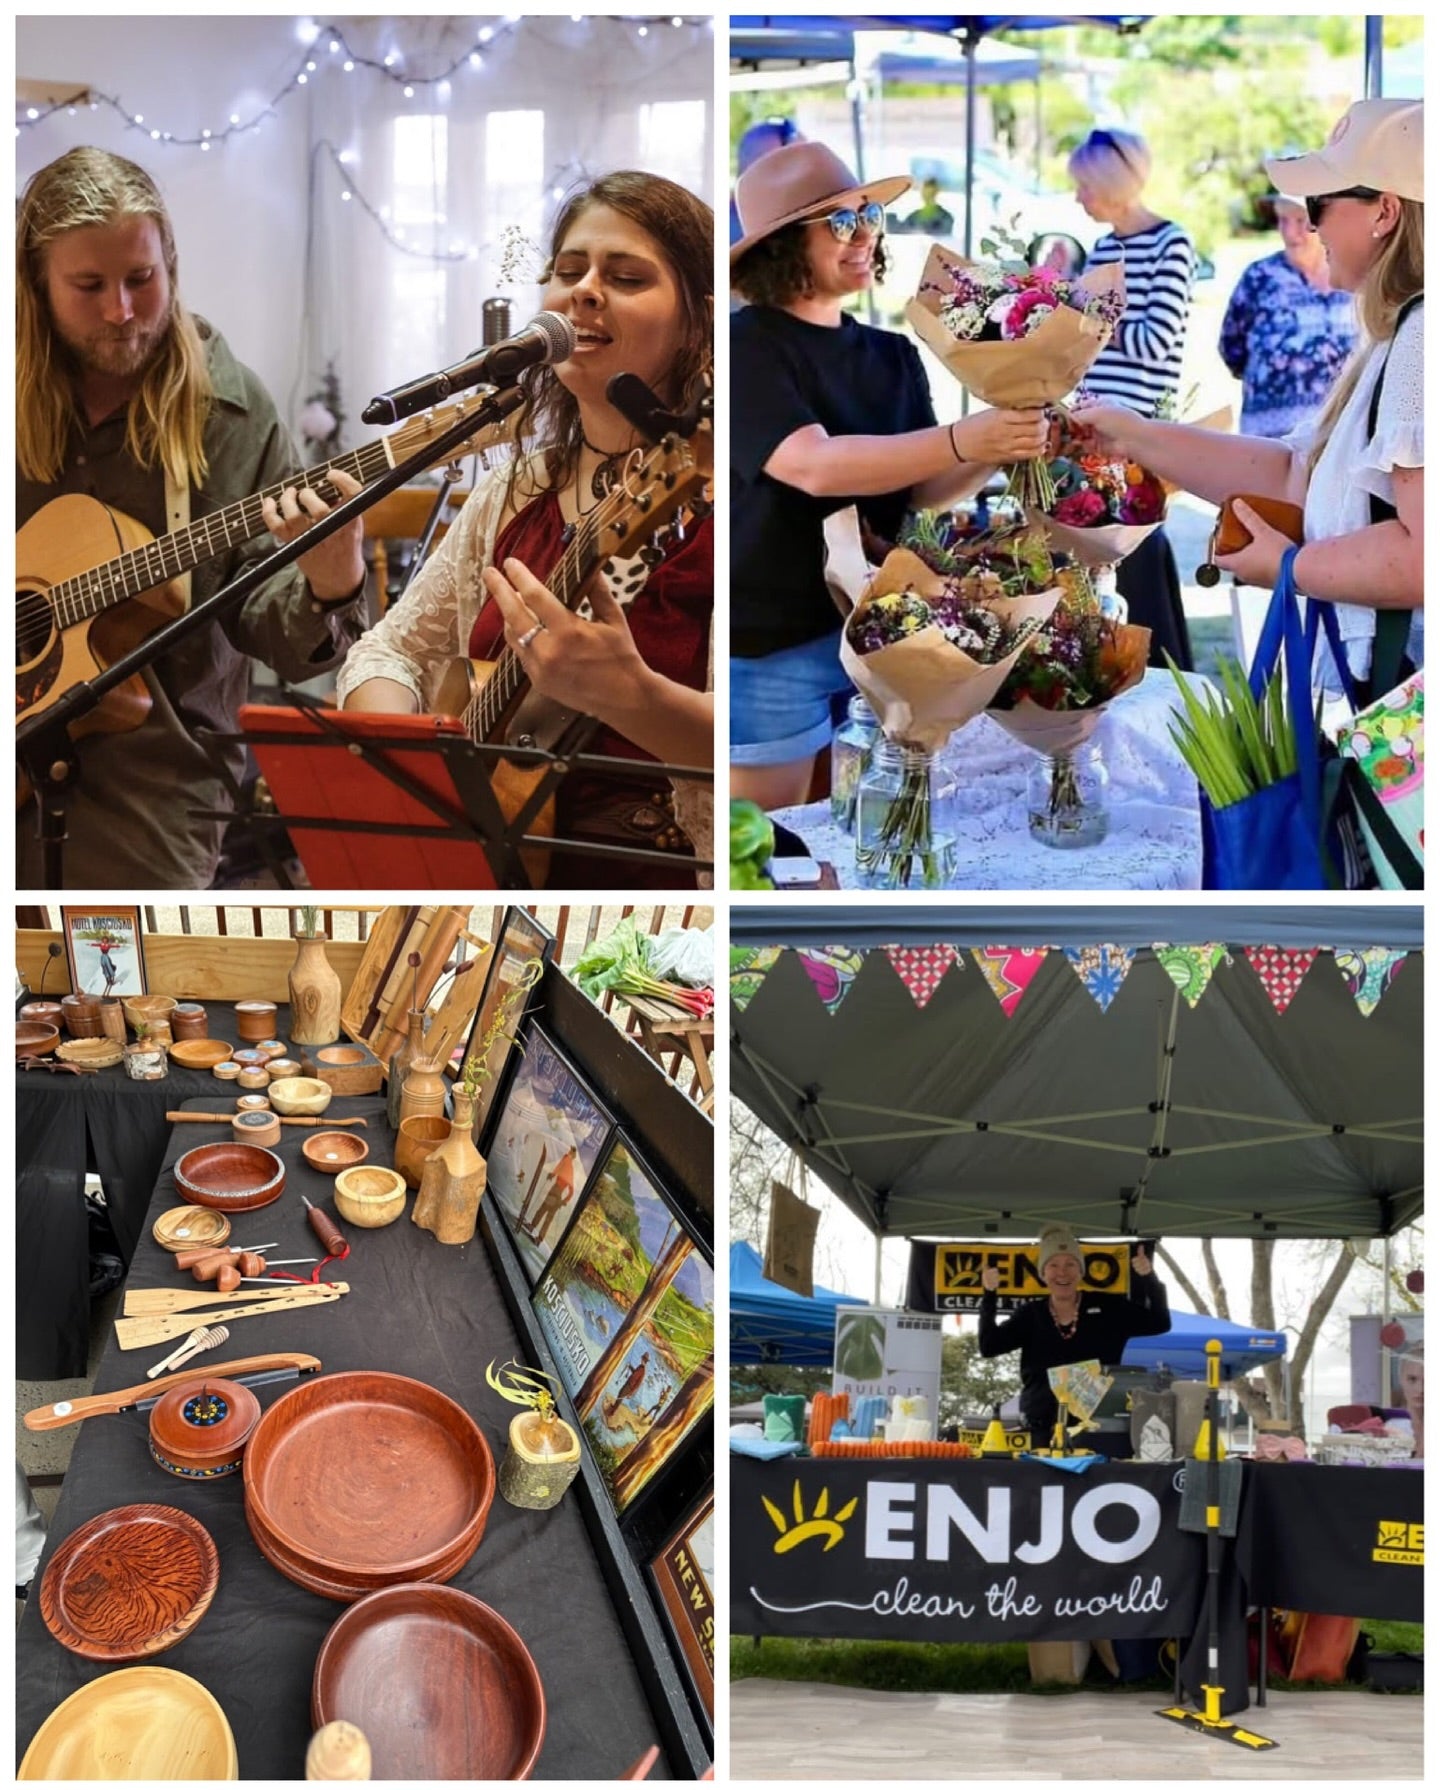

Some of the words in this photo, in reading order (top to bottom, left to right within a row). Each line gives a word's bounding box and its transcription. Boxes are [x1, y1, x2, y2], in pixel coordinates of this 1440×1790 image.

[988, 1252, 1120, 1288] ENO
[543, 1275, 590, 1376] KOSCIUSKO
[844, 1384, 897, 1395] BUILD
[865, 1481, 1161, 1563] ENJO
[675, 1549, 707, 1610] NEW
[1378, 1551, 1421, 1562] CLEAN
[870, 1576, 975, 1618] clean
[984, 1576, 1042, 1621] the
[1054, 1575, 1168, 1616] world
